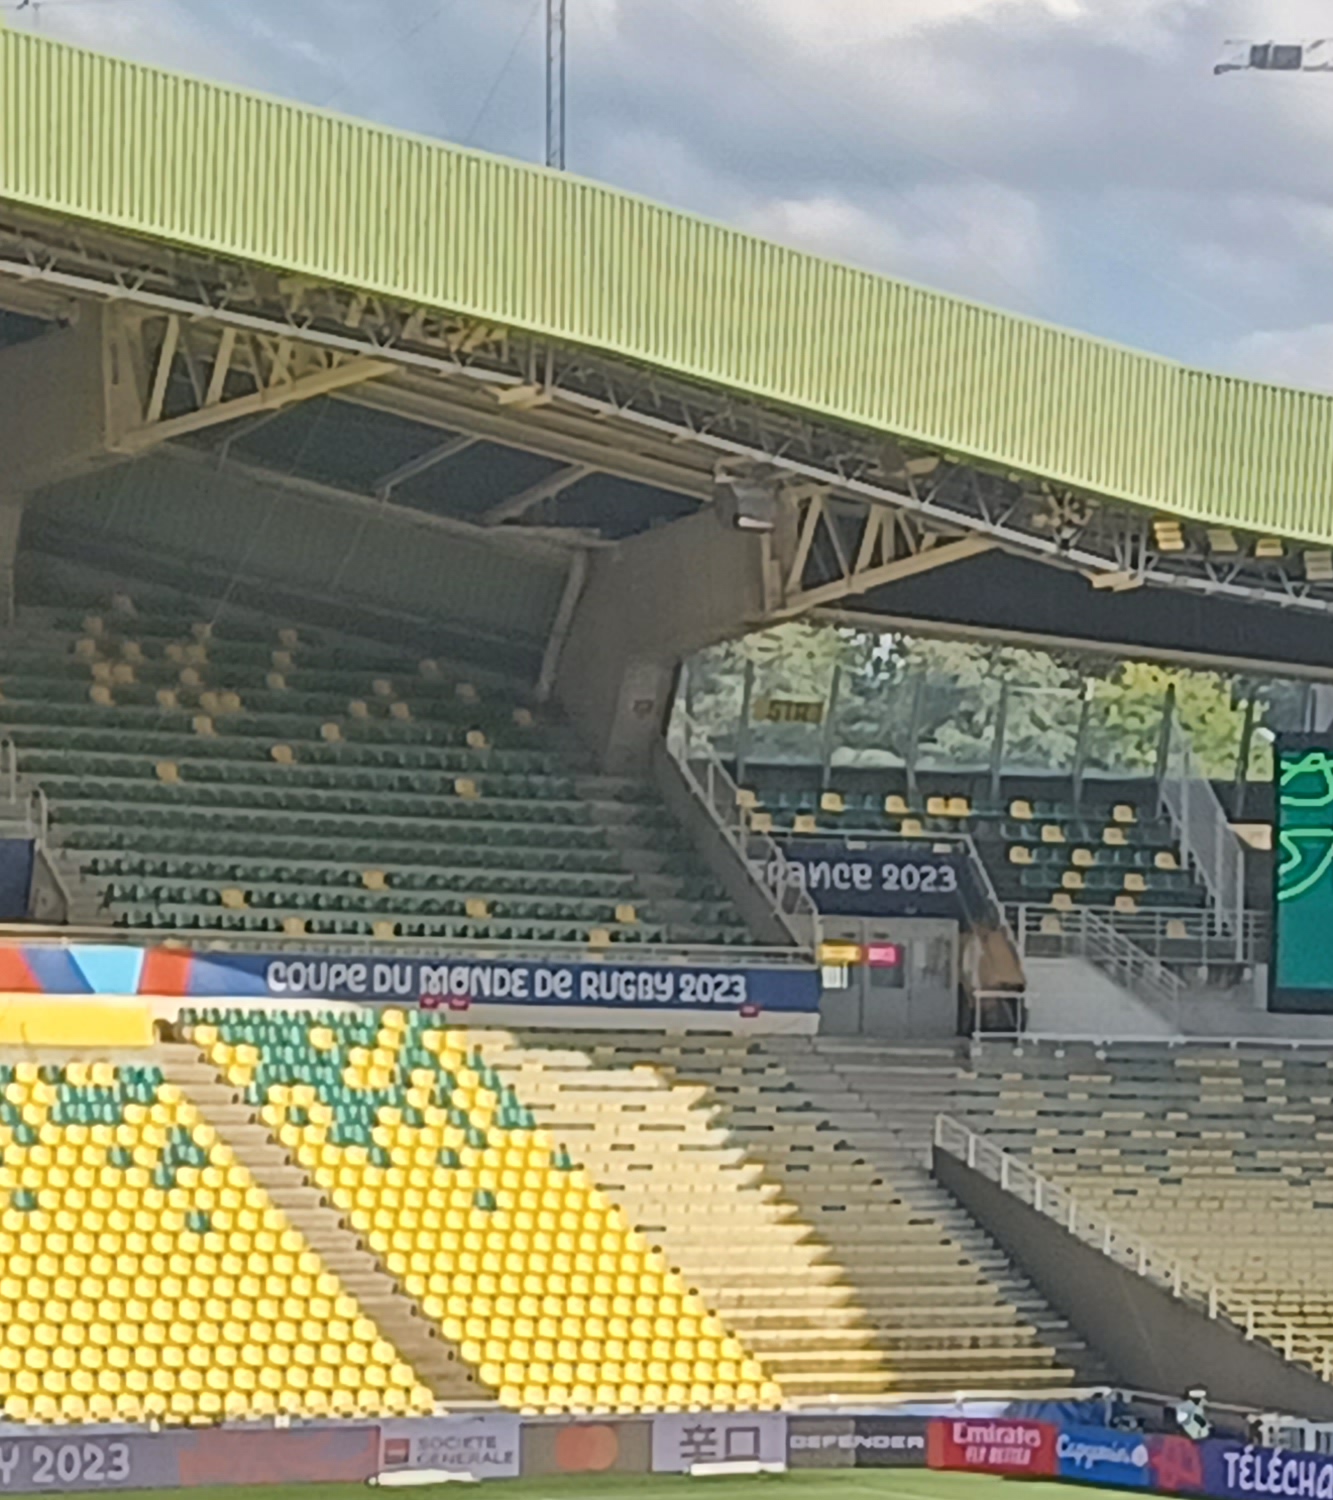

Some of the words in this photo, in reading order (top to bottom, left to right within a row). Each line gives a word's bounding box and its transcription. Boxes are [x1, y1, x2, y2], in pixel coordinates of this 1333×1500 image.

[881, 862, 958, 893] 2023
[372, 963, 413, 994] DU
[418, 964, 529, 998] MONDE
[579, 969, 674, 1002] RUGBY
[678, 972, 748, 1004] 2023
[789, 1435, 925, 1450] DEFENDER
[32, 1442, 131, 1483] 2023
